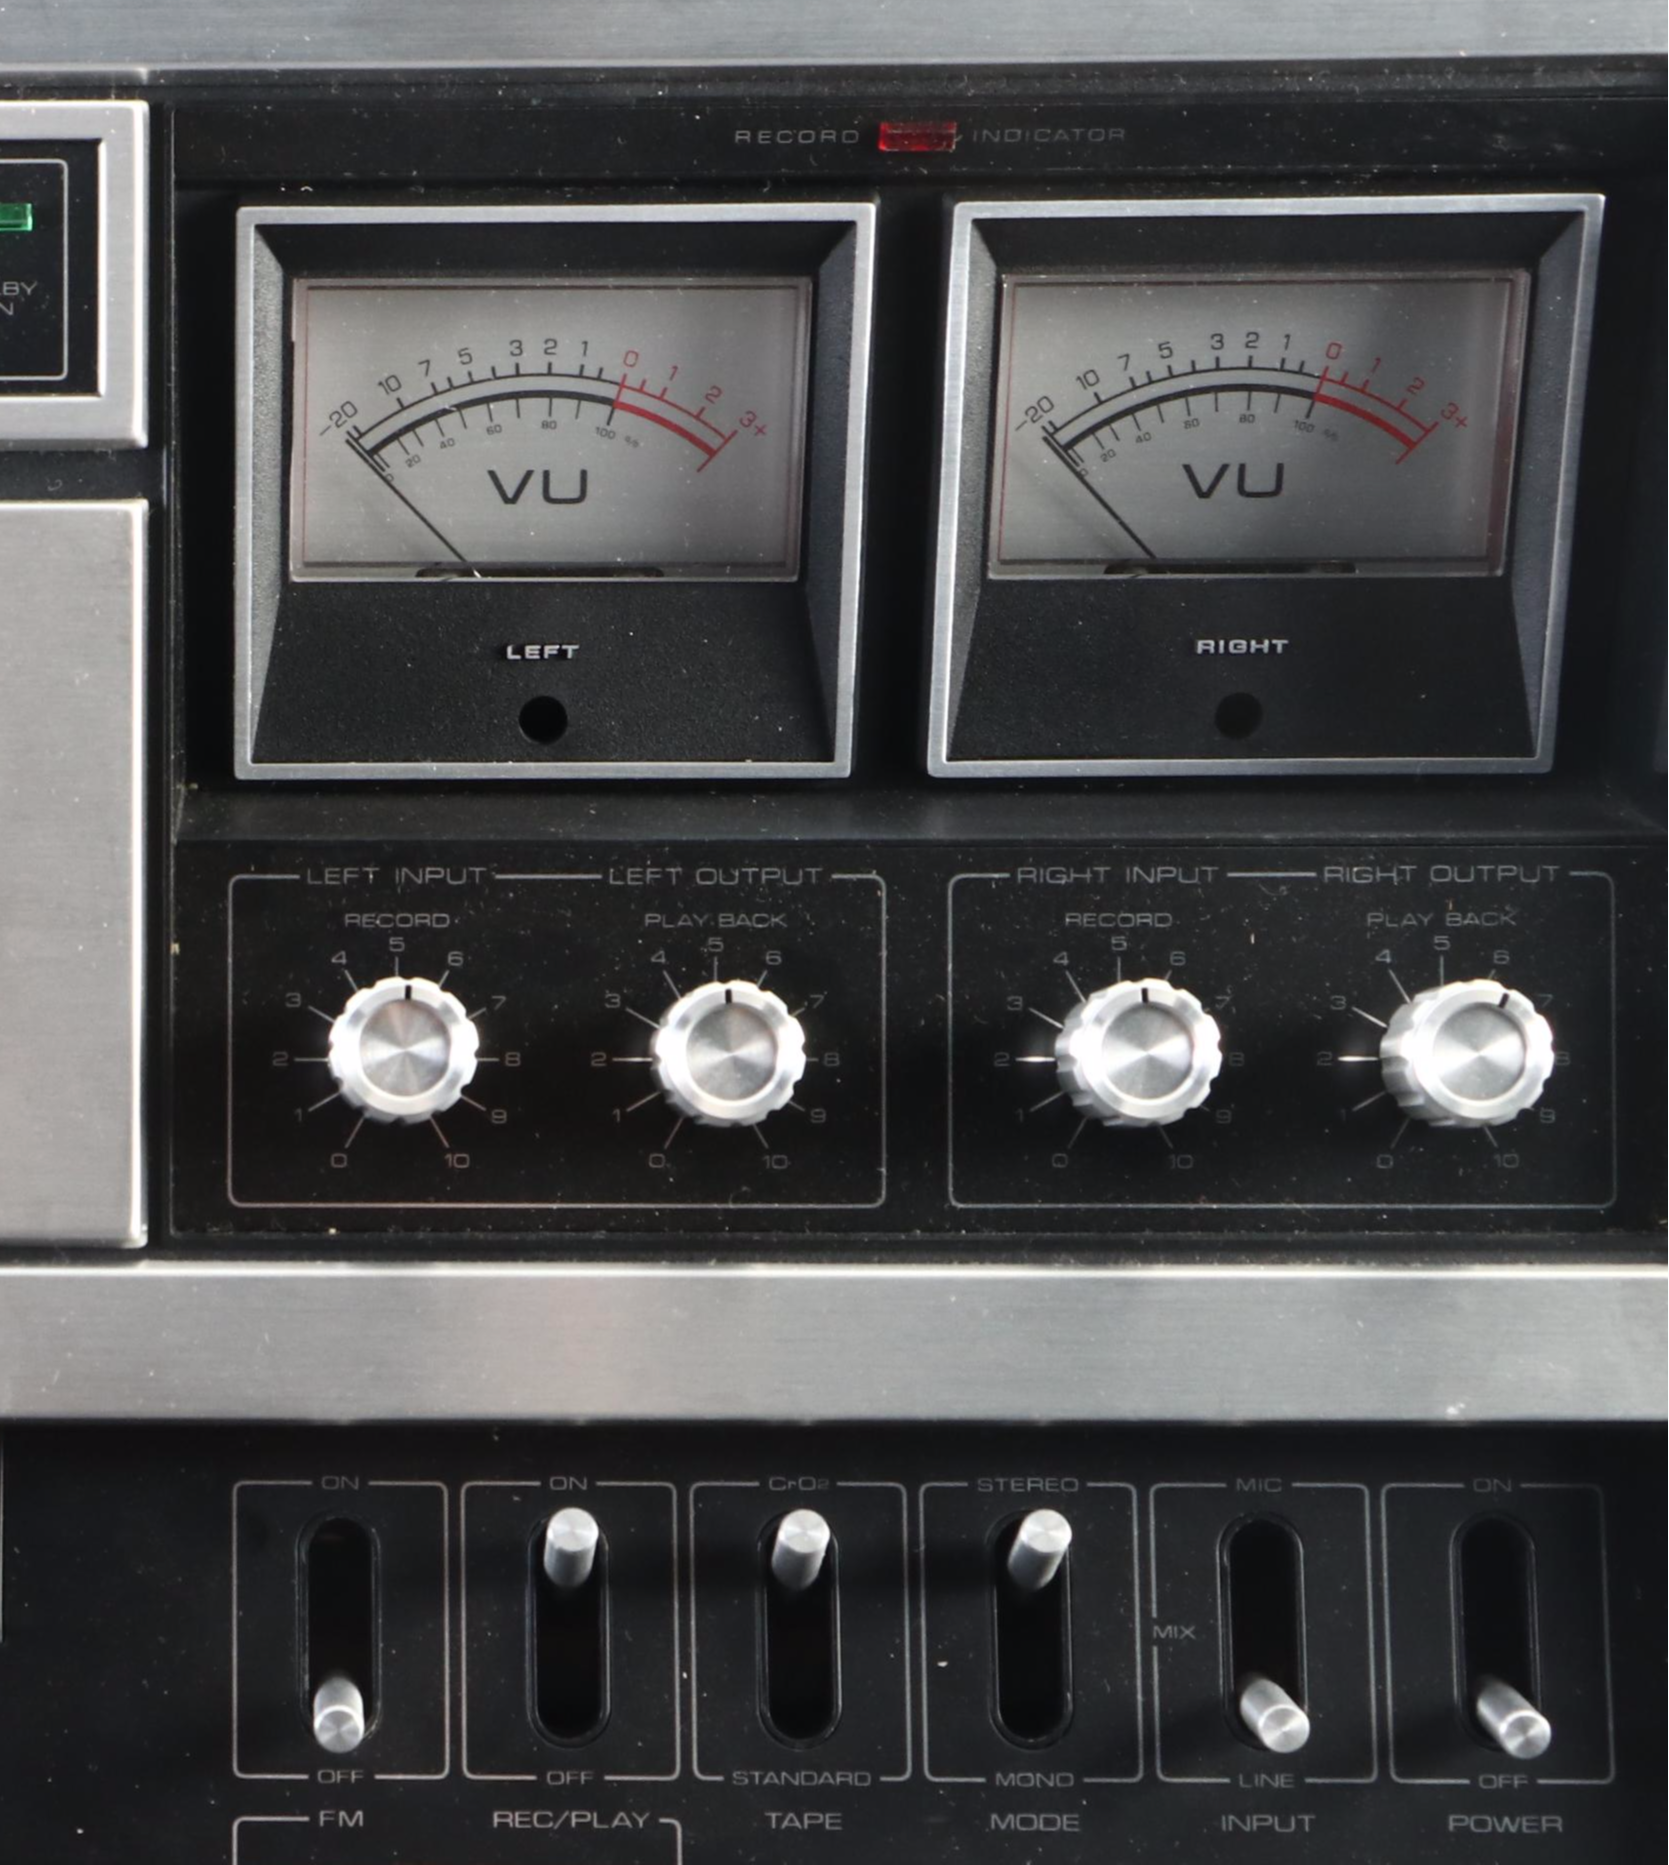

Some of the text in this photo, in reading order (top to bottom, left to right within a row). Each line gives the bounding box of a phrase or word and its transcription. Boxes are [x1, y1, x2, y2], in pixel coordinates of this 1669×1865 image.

[735, 129, 1126, 144] RECORD INDICATOR
[378, 375, 402, 395] 10
[418, 359, 431, 377] 7
[458, 347, 473, 365] 5
[510, 339, 523, 357] 3
[544, 339, 558, 355] 2
[582, 341, 588, 357] 1
[623, 350, 639, 368] 0
[669, 365, 679, 381] 1
[704, 385, 723, 404] 2
[1076, 369, 1100, 390] 10
[1117, 353, 1130, 371] 7
[1158, 342, 1173, 359] 5
[1211, 333, 1224, 350] 3
[1245, 332, 1259, 348] 2
[1284, 334, 1291, 350] 1
[1326, 342, 1342, 360] 0
[1371, 357, 1382, 373] 1
[1406, 377, 1425, 396] 2
[405, 420, 616, 468] 20 40 60 80 100
[1100, 420, 1315, 462] 20 40 100
[488, 469, 588, 505] VU
[1183, 464, 1284, 499] VU
[506, 644, 580, 660] LEFT
[1196, 639, 1289, 654] RIGHT
[307, 868, 486, 886] LEFT INPUT
[609, 868, 823, 886] LEFT OUTPUT
[1016, 866, 1219, 885] RIGHT INPUT
[1323, 865, 1560, 884] RIGHT OUTPUT
[344, 913, 450, 929] RECORD
[644, 913, 787, 928] PLAY BACK
[1065, 912, 1173, 928] RECORD
[1366, 911, 1517, 928] PLAY BACK
[1434, 936, 1450, 950] 5
[1375, 949, 1391, 963] 4
[1494, 950, 1510, 964] 6
[1330, 996, 1346, 1010] 3
[273, 937, 520, 1168] 0 1 2 3 4 5 6 7 8 9 10
[591, 937, 839, 1169] 0 1 2 3 4 5 6 8 9 10
[994, 937, 1231, 1169] 0 1 2 3 4 5 6 9 10
[1317, 1051, 1332, 1065] 2
[1540, 1108, 1555, 1123] 9
[1377, 1154, 1393, 1168] 0
[1494, 1154, 1519, 1168] 10
[321, 1476, 359, 1490] ON
[550, 1476, 587, 1490] ON
[976, 1478, 1079, 1492] STEREO
[1236, 1478, 1283, 1492] MIC
[1473, 1478, 1512, 1492] ON
[1152, 1625, 1196, 1640] MIX
[317, 1770, 365, 1785] OFF
[546, 1771, 594, 1786] OFF
[732, 1771, 871, 1786] STANDARD
[995, 1772, 1074, 1787] MONO
[1238, 1773, 1295, 1788] LINE
[1478, 1773, 1529, 1789] OFF
[319, 1812, 364, 1827] FM
[492, 1812, 650, 1830] REC/PLAY
[765, 1813, 843, 1830] TAPE
[990, 1814, 1080, 1832] MODE
[1221, 1815, 1315, 1832] INPUT
[1448, 1816, 1563, 1833] POWER
